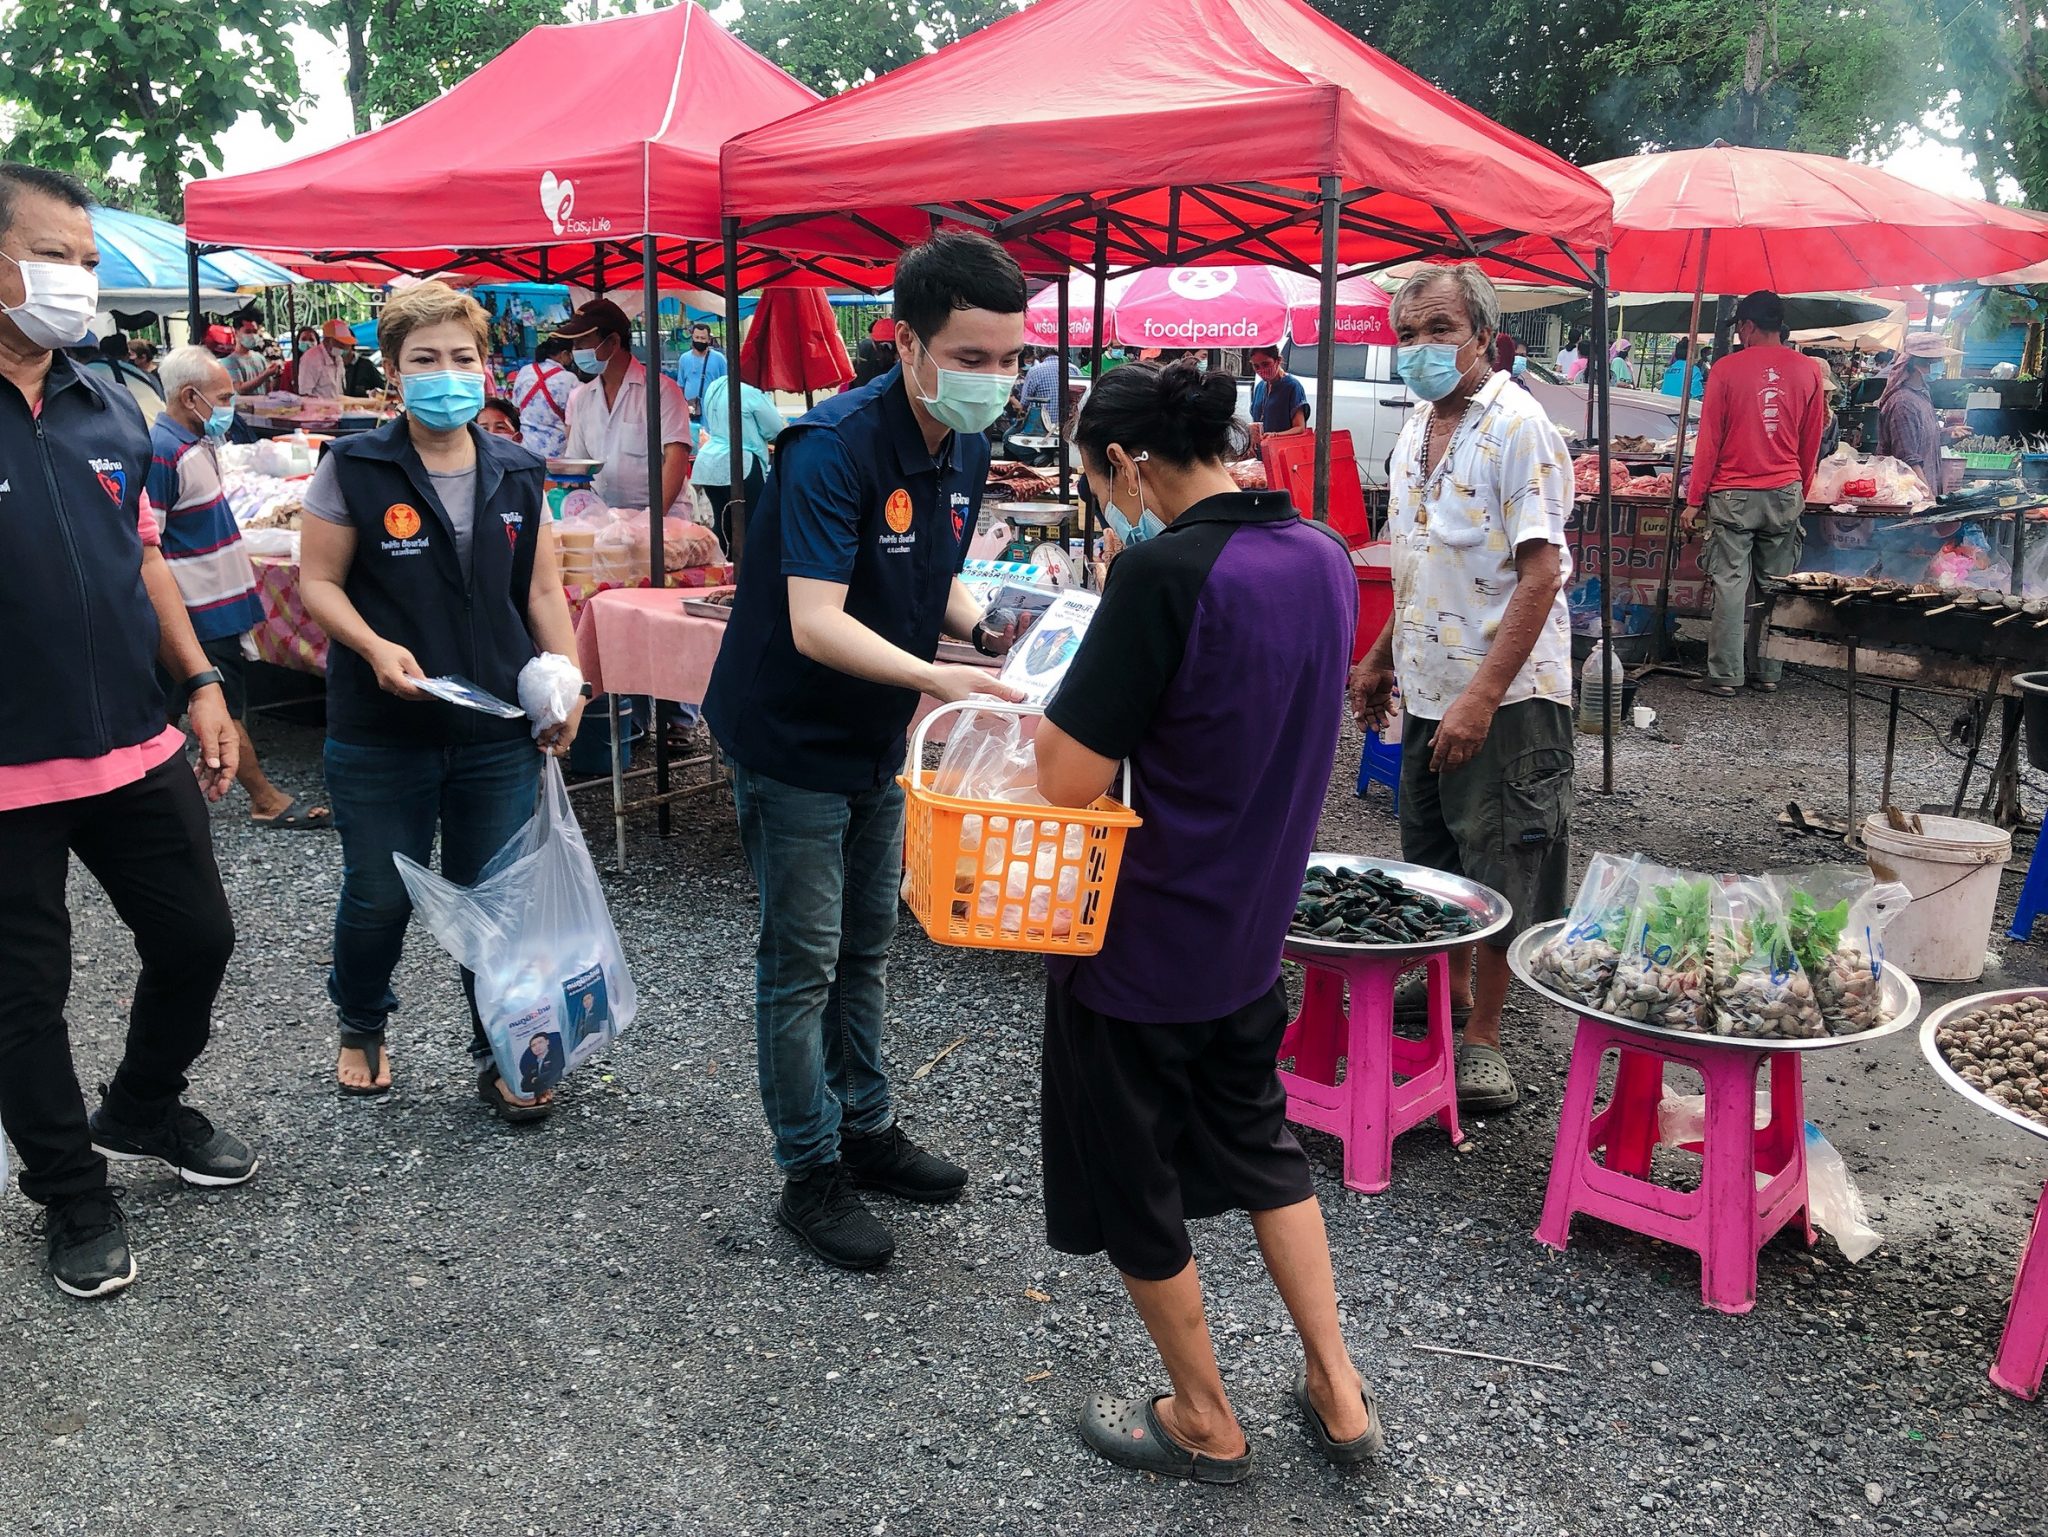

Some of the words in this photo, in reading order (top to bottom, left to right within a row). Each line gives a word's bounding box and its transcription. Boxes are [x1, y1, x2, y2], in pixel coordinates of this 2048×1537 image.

[566, 218, 592, 236] Easy
[591, 216, 611, 232] Life
[1144, 317, 1258, 342] foodpanda
